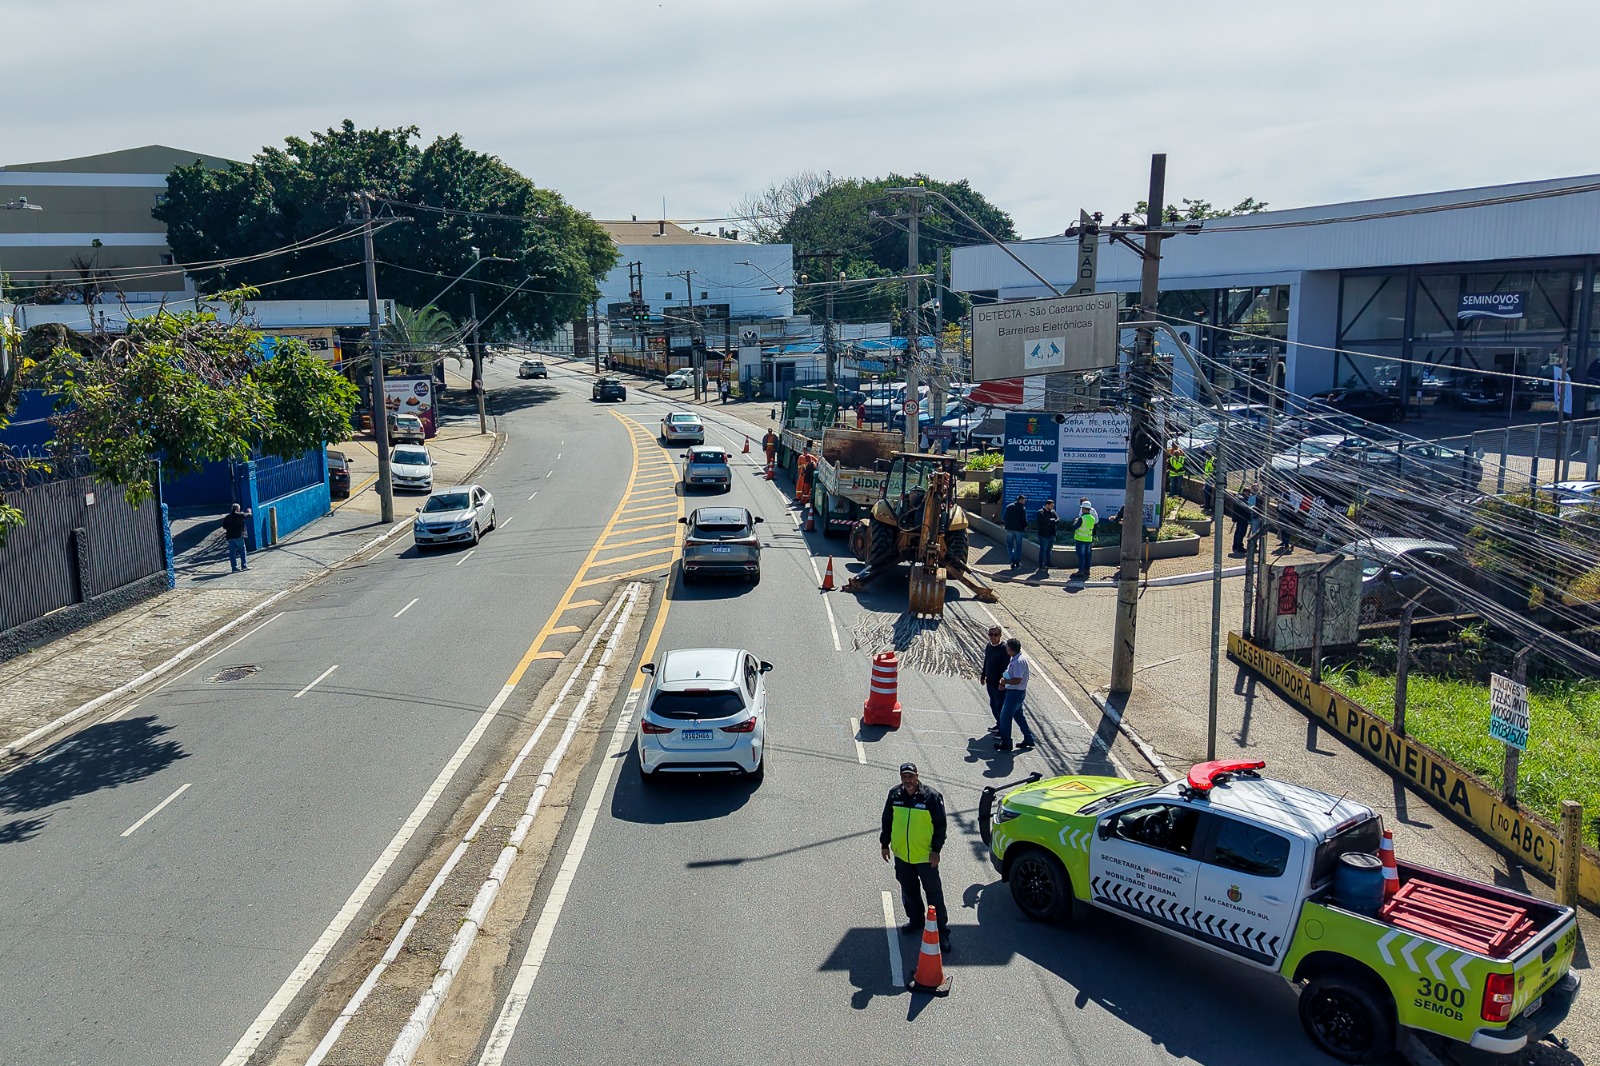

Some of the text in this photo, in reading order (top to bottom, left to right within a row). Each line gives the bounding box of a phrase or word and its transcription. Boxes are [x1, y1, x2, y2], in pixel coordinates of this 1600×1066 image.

[979, 309, 1022, 322] DETECTA
[1030, 307, 1046, 316] São
[1048, 304, 1084, 315] Caetano
[1086, 302, 1096, 311] do
[1098, 300, 1112, 309] Sul
[1462, 294, 1520, 304] SEMINOVOS
[998, 320, 1092, 336] Barreiras Eletrônicas
[1492, 688, 1529, 714] TELAS ANTI
[1237, 640, 1312, 706] DESENTUPIDORA
[1326, 698, 1338, 726] A
[1346, 708, 1472, 818] PIONEIRA
[1492, 704, 1529, 730] MOSQUITOS
[1101, 854, 1182, 884] SECRETARIA MUNICIPAL
[1106, 870, 1177, 898] MOBILIDADE URBANA
[1217, 900, 1246, 912] CAETANO
[1417, 977, 1465, 1008] 300
[1414, 998, 1463, 1021] SEMOB
